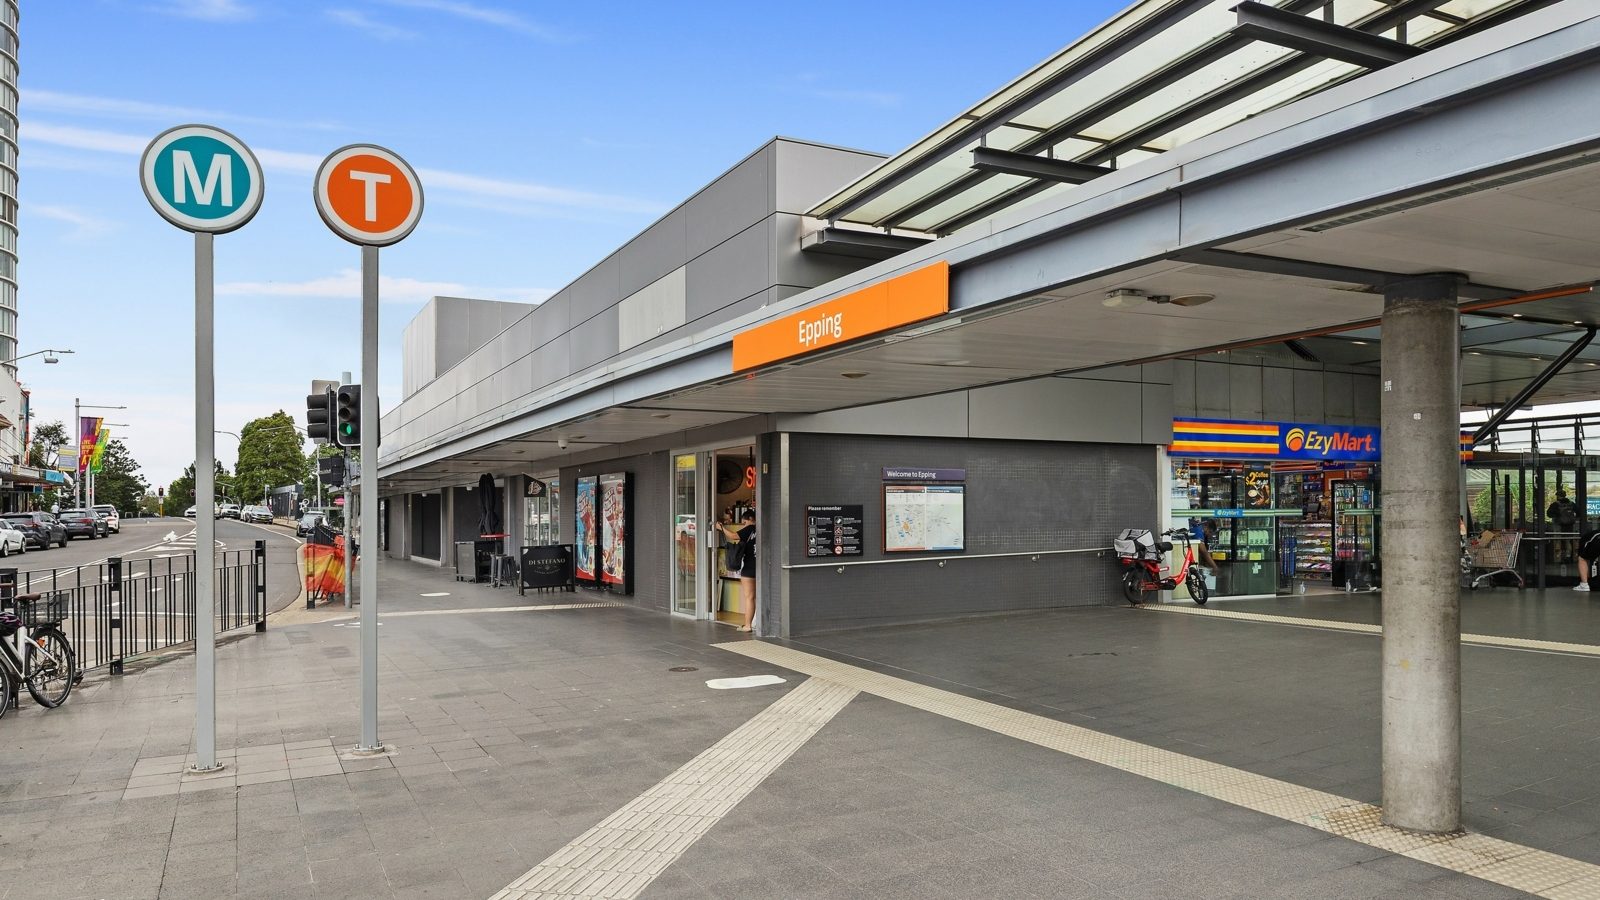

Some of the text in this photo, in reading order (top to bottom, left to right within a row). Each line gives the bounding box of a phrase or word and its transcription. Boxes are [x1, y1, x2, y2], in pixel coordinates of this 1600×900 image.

[172, 149, 233, 207] M
[349, 169, 392, 222] T
[798, 312, 843, 347] Epping
[1304, 430, 1373, 456] EzyMart
[886, 470, 912, 478] Welcome
[918, 471, 937, 479] Epping
